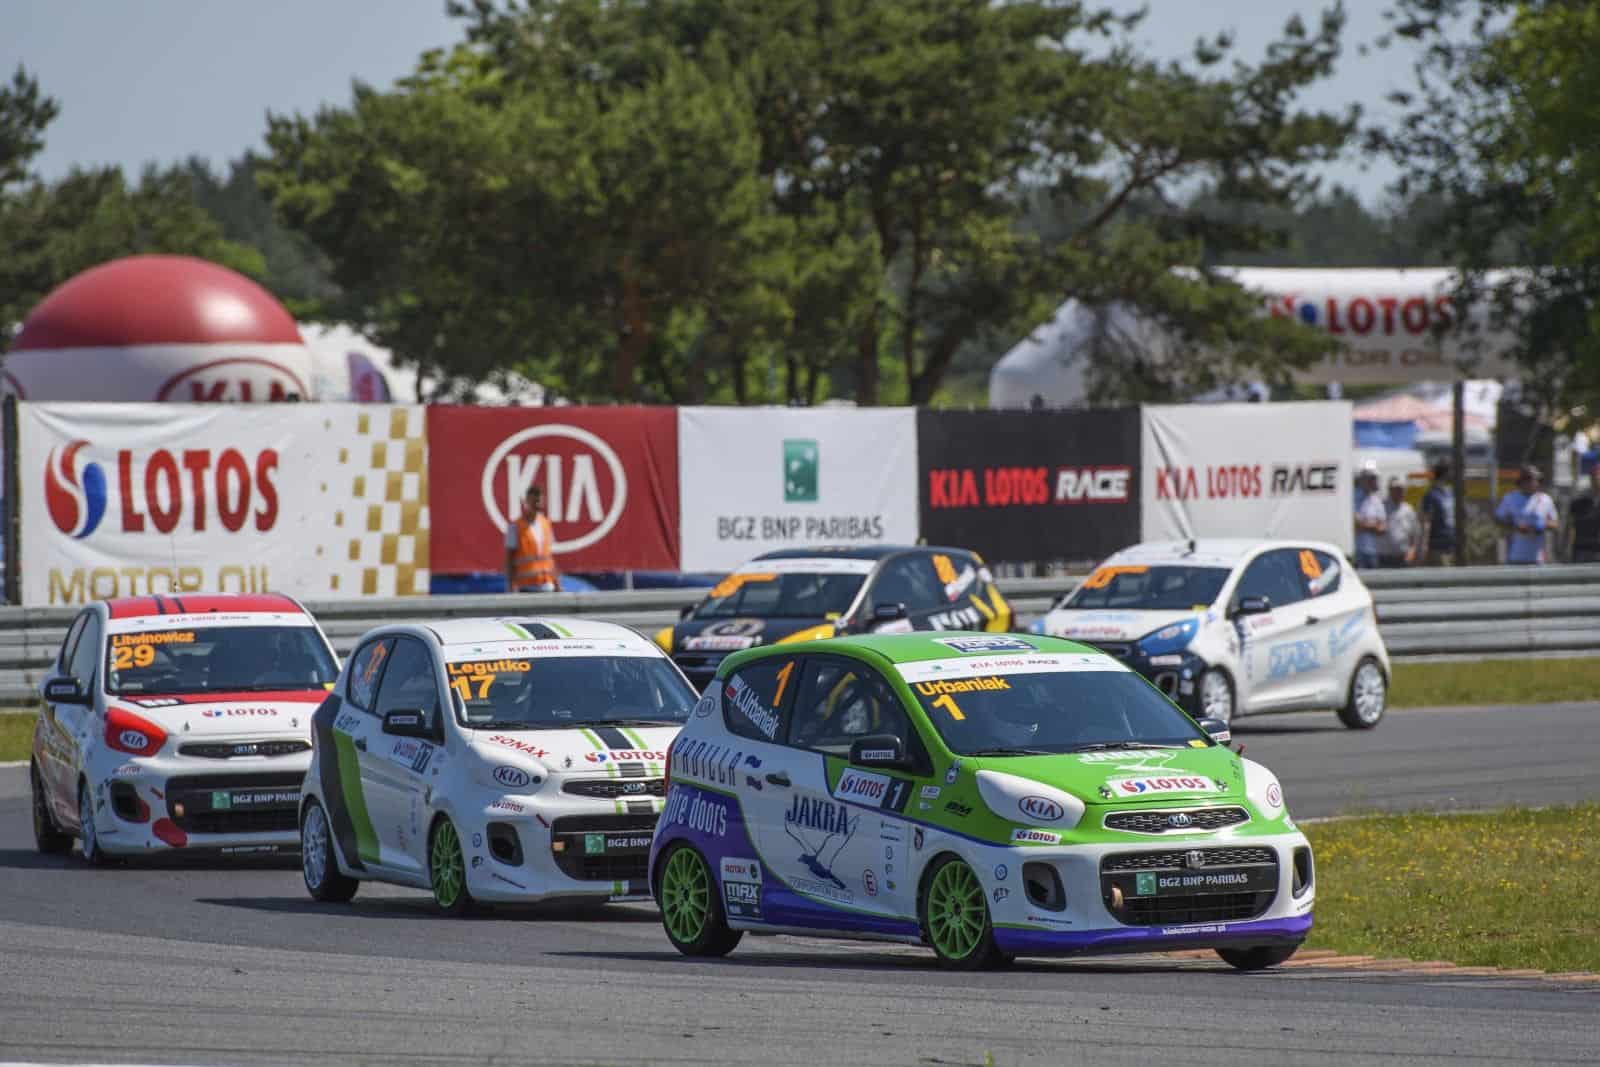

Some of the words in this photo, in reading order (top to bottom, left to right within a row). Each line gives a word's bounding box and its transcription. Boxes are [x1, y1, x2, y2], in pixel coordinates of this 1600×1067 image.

[1325, 296, 1454, 336] LOTOS
[118, 448, 279, 534] LOTOS
[505, 454, 605, 523] KIA
[929, 469, 979, 507] KIA
[984, 467, 1049, 506] LOTOS
[1056, 469, 1131, 500] RACE
[1156, 466, 1199, 500] KIA
[1206, 464, 1263, 499] LOTOS
[1272, 464, 1338, 494] RACE
[761, 516, 801, 541] BNP
[805, 514, 885, 540] PARIBAS
[48, 566, 204, 604] MOTOR
[112, 644, 155, 671] 29
[448, 660, 531, 676] Legutko
[449, 674, 496, 700] 17
[772, 660, 795, 707] 1
[916, 676, 1011, 697] Urbaniak
[225, 707, 279, 717] LOTOS
[931, 694, 966, 721] 1
[123, 733, 145, 746] KIA
[489, 735, 550, 758] SONAX
[609, 751, 665, 761] LOTOS
[498, 769, 524, 785] KIA
[852, 777, 885, 799] LOTOS
[1146, 777, 1208, 790] LOTOS
[891, 782, 905, 809] 1
[1025, 799, 1056, 818] KIA
[689, 792, 727, 837] doors
[785, 794, 848, 835] JAKRA
[1028, 831, 1056, 842] LOTOS
[1183, 876, 1205, 886] BNP
[1206, 873, 1248, 885] PARIBAS
